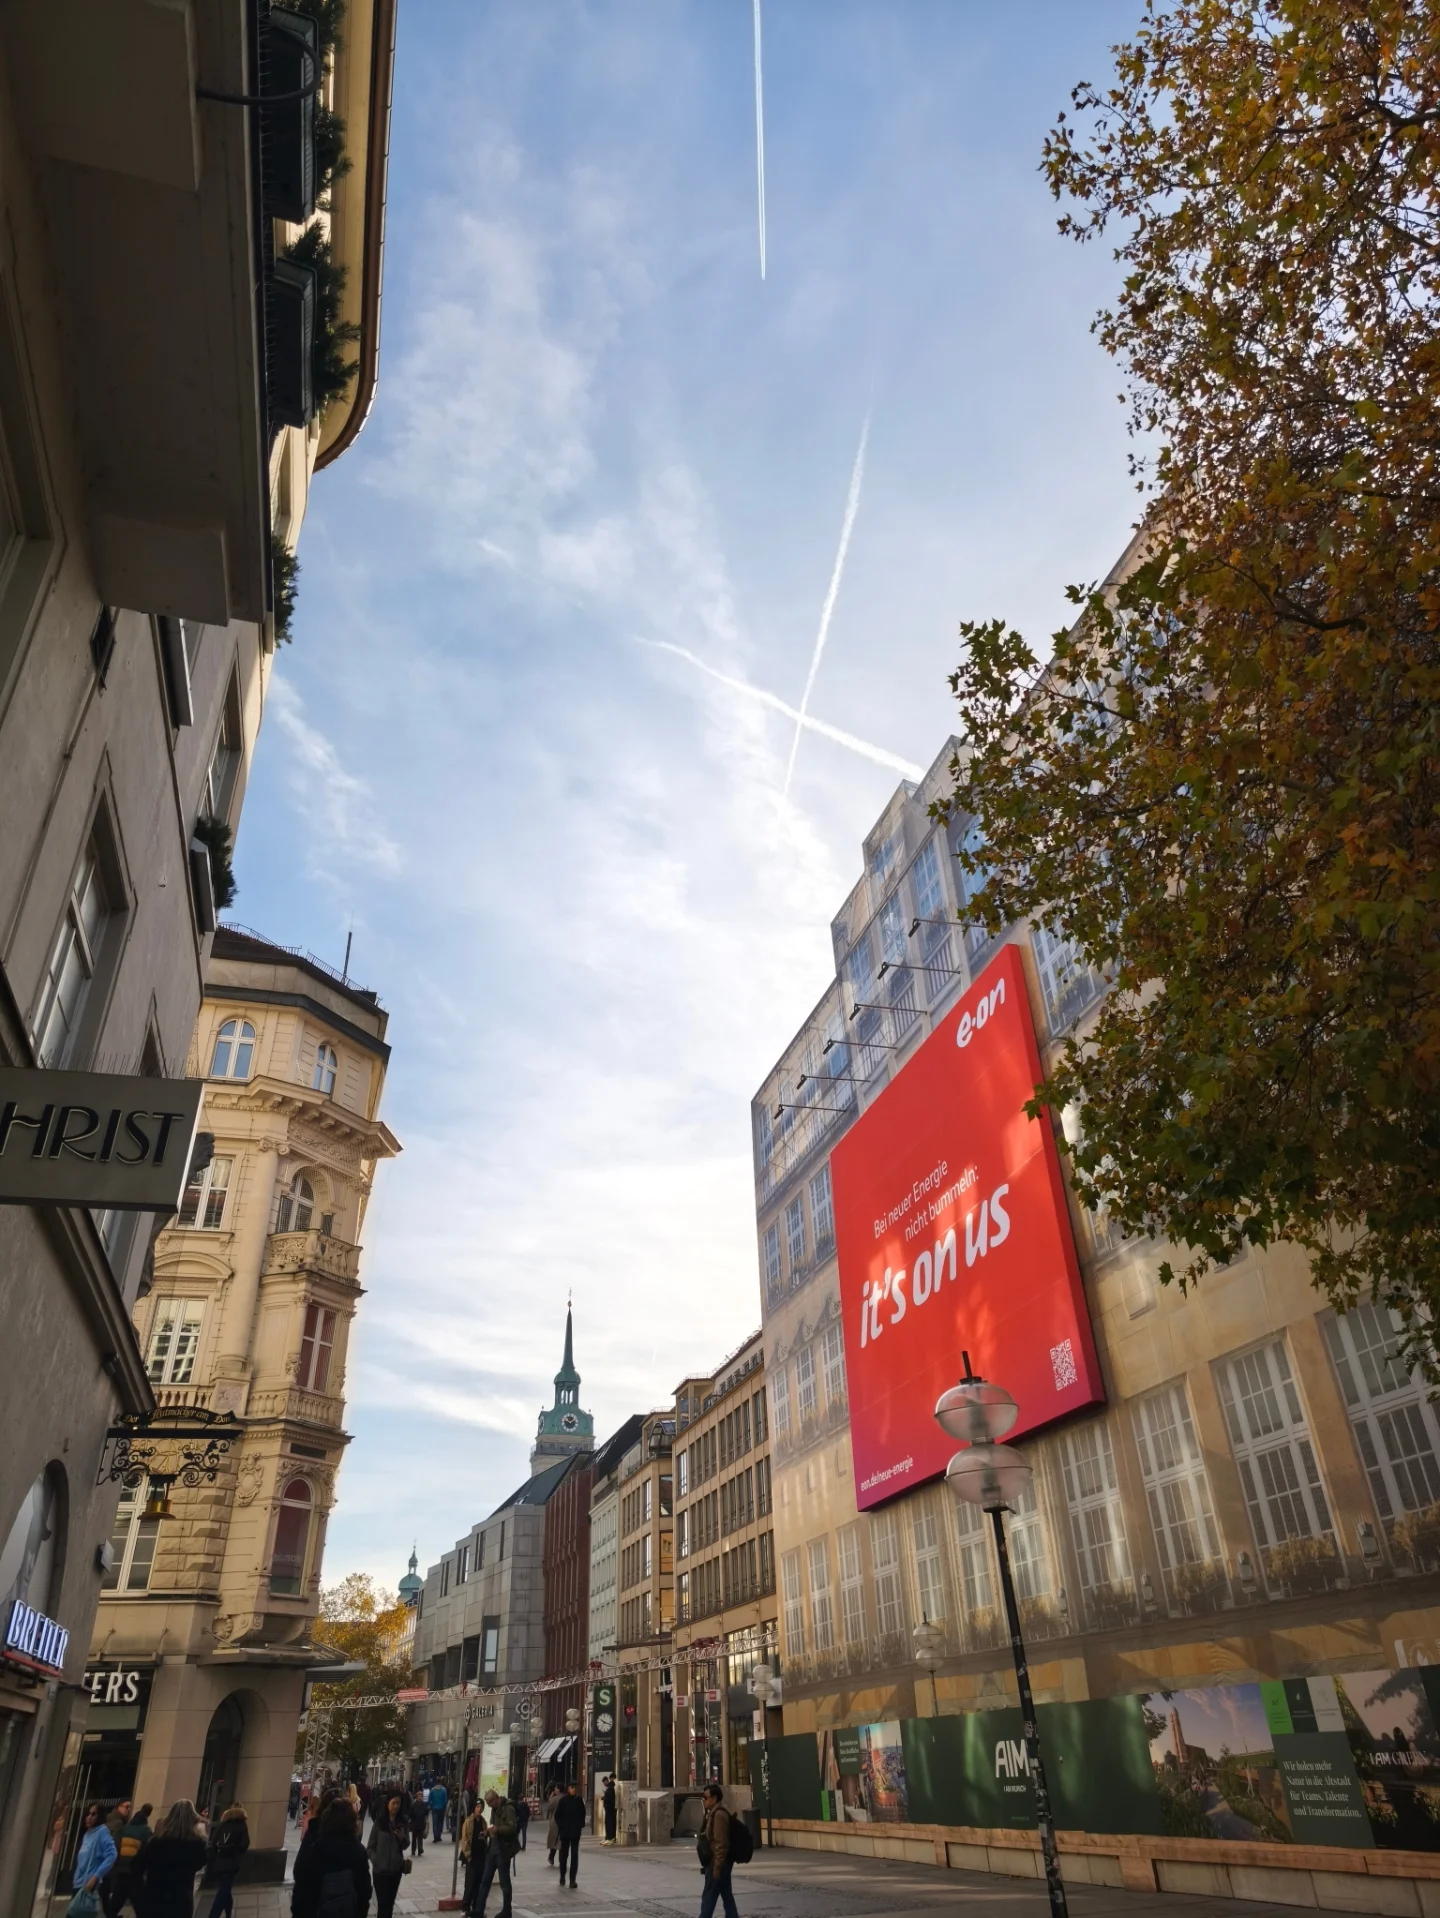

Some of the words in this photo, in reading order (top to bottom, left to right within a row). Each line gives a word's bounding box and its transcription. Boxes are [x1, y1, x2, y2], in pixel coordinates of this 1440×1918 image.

[0, 1101, 185, 1167] HRIST
[873, 1217, 888, 1239] Bei
[887, 1194, 913, 1226] neuer
[912, 1159, 949, 1203] Energie
[904, 1212, 929, 1242] nicht
[929, 1164, 980, 1220] bummeln:
[860, 1267, 907, 1348] it's
[912, 1228, 958, 1306] on
[965, 1183, 1011, 1268] us
[6, 1599, 70, 1670] BREITER
[82, 1670, 140, 1704] ERS
[599, 1689, 611, 1706] S
[995, 1738, 1031, 1778] AIM
[1282, 1760, 1296, 1771] Wir
[1296, 1760, 1315, 1771] holen
[1314, 1760, 1332, 1771] mehr
[1375, 1752, 1391, 1765] AM
[1391, 1750, 1429, 1766] GREEN
[1286, 1775, 1305, 1786] Natur
[1305, 1776, 1313, 1786] in
[1312, 1775, 1323, 1786] die
[1324, 1775, 1352, 1787] Altstadt
[1289, 1789, 1301, 1801] für
[1324, 1790, 1350, 1802] Talente
[1293, 1805, 1307, 1816] und
[1307, 1805, 1362, 1818] Transformation.
